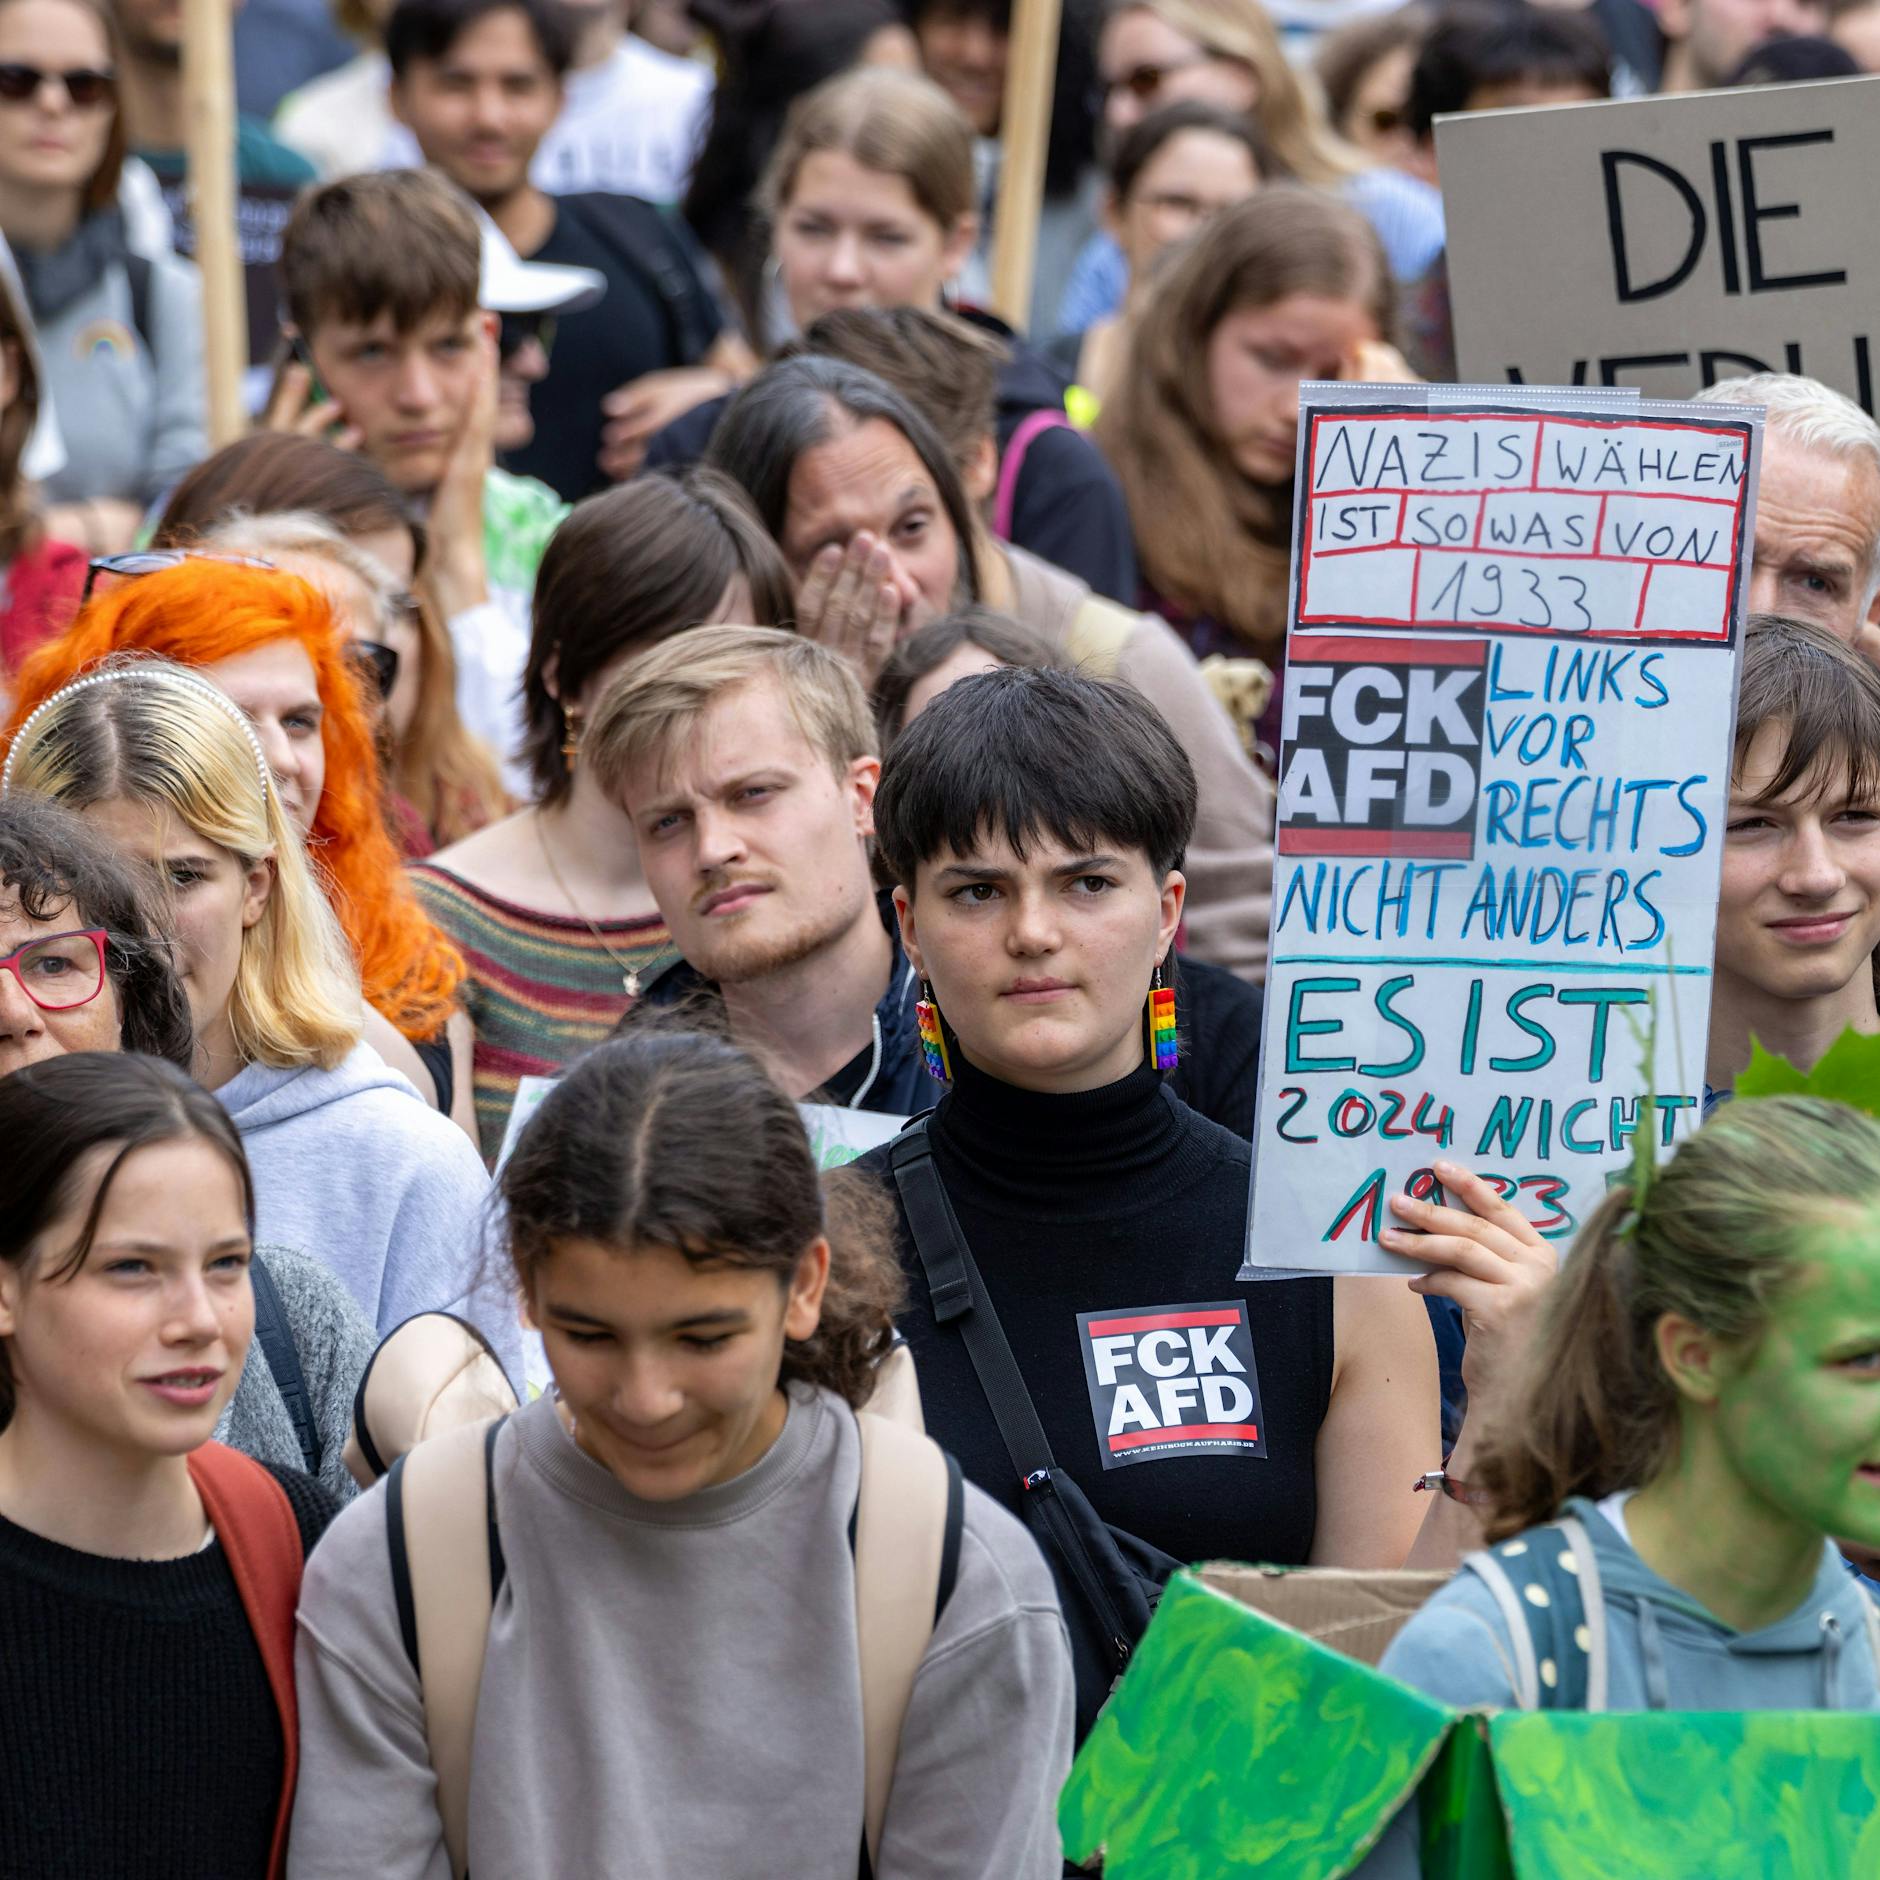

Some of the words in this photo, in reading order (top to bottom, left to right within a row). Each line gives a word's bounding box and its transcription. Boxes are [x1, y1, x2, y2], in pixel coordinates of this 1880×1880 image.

[1600, 128, 1847, 304] DIE
[1316, 426, 1523, 490] NAZIS
[1556, 439, 1747, 486] WÄHLEN
[1319, 505, 1391, 541] IST
[1411, 507, 1468, 547] SO
[1490, 511, 1585, 549] WAS
[1614, 521, 1719, 563] VON
[1431, 559, 1593, 632] 1933
[1283, 666, 1482, 745] FCK
[1489, 643, 1669, 708] LINKS
[1485, 709, 1595, 769] VOR
[1279, 748, 1476, 826] AFD
[1483, 775, 1708, 857] RECHTS
[1277, 859, 1467, 941] NICHT
[1461, 862, 1666, 954] ANDERS
[1285, 974, 1426, 1079] ES
[1460, 979, 1652, 1083] IST
[1276, 1086, 1455, 1149] 2024
[1475, 1095, 1698, 1160] NICHT
[1091, 1325, 1247, 1386] FCK
[1107, 1375, 1254, 1436] AFD
